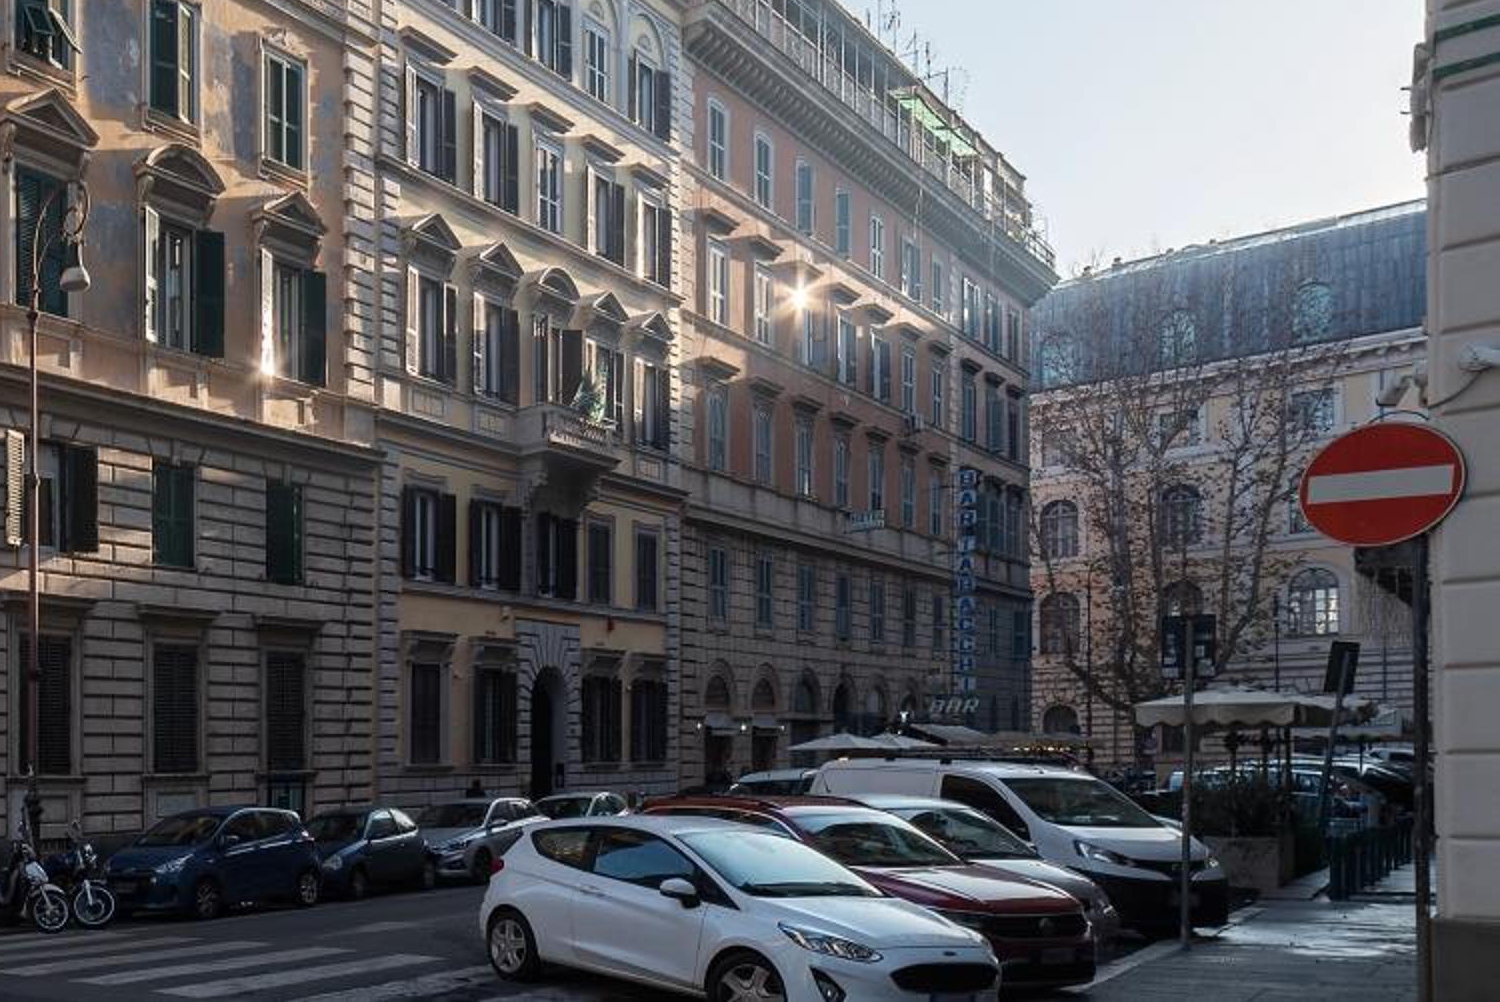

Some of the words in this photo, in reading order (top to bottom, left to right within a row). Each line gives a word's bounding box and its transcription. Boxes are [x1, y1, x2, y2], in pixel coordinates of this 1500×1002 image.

[959, 470, 976, 528] BAR
[959, 535, 975, 691] TABACCHI
[931, 698, 980, 714] BAR
